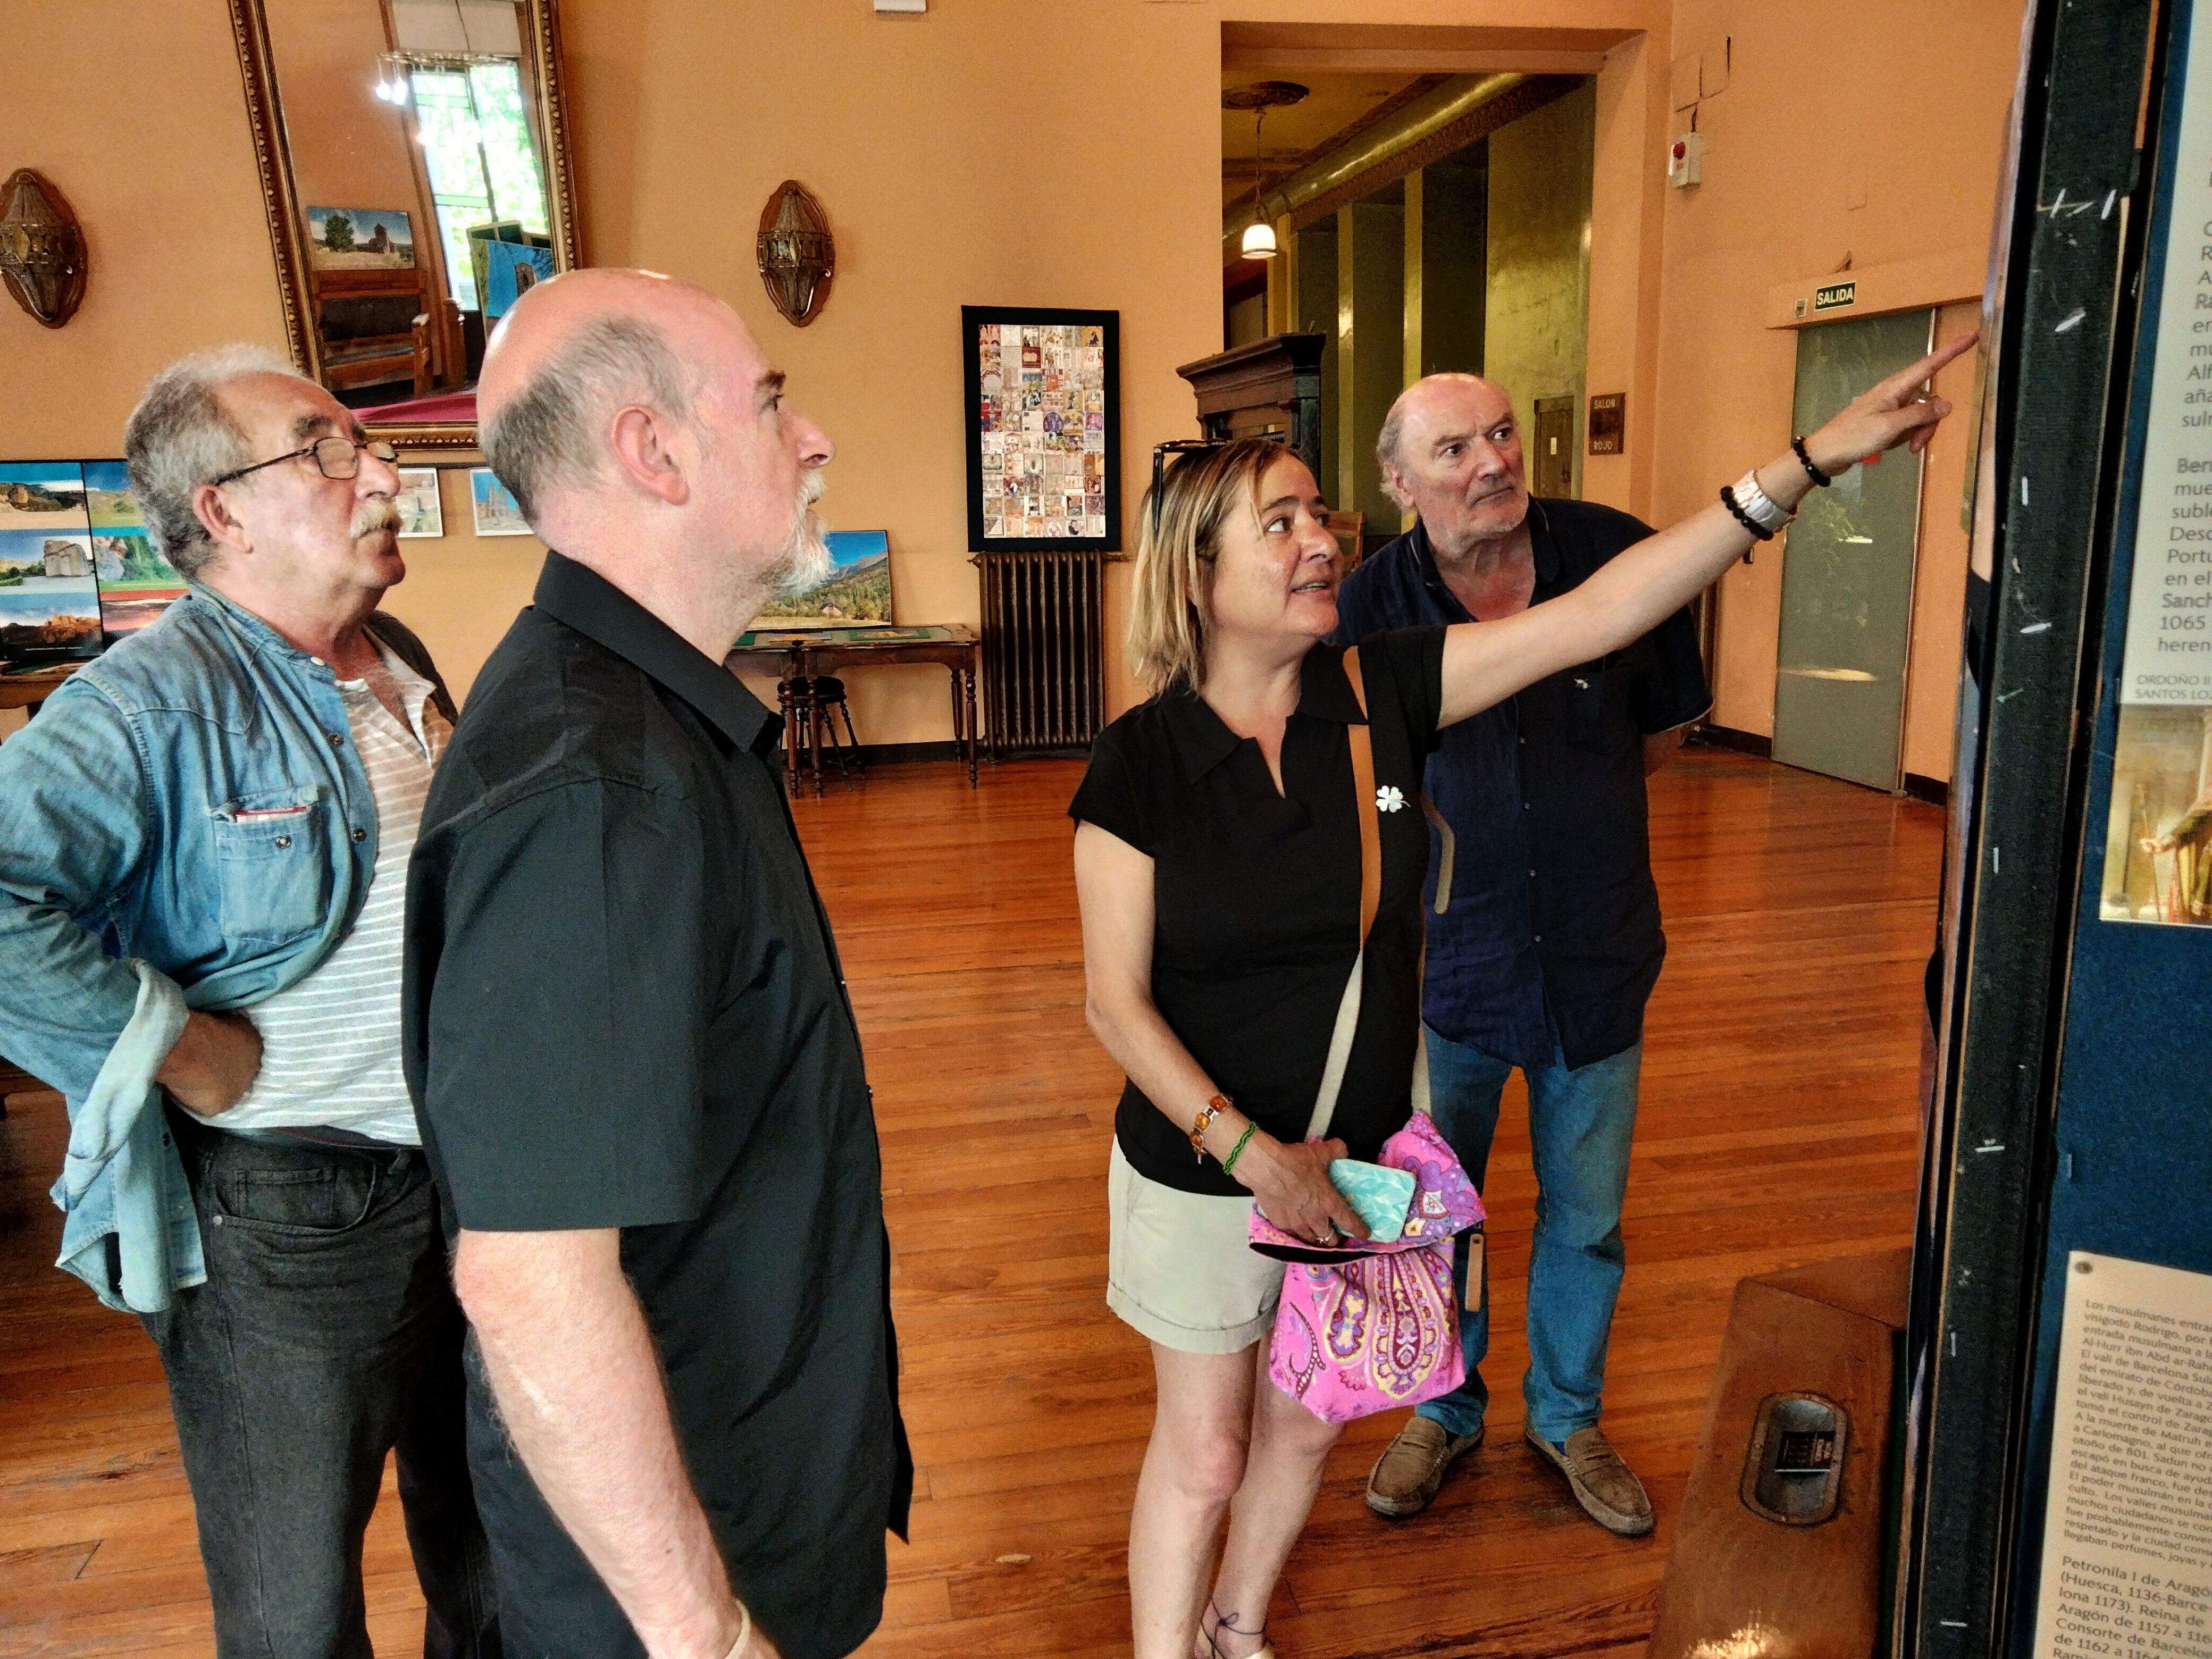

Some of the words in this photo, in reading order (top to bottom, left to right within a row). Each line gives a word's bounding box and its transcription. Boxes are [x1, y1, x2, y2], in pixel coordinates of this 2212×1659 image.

[2197, 270, 2212, 285] A
[1817, 287, 1854, 305] SALIDA
[2165, 573, 2188, 586] en
[2194, 571, 2211, 585] el
[2160, 615, 2206, 631] 1065
[2134, 688, 2186, 699] SANTOS
[2085, 1298, 2104, 1310] Los
[2107, 1305, 2175, 1325] musulmanes
[2083, 1325, 2125, 1340] entrada
[2128, 1335, 2192, 1354] musulmana
[2084, 1312, 2130, 1328] visigodo
[2185, 1335, 2205, 1344] por
[2080, 1348, 2090, 1359] El
[2115, 1356, 2129, 1367] de
[2133, 1360, 2188, 1379] Barcelona
[2125, 1345, 2142, 1356] ibn
[2147, 1350, 2169, 1362] Abd
[2079, 1361, 2097, 1373] del
[2100, 1368, 2143, 1382] emirato
[2146, 1376, 2160, 1386] de
[2077, 1387, 2087, 1396] el
[2113, 1394, 2153, 1412] Husayn
[2156, 1403, 2172, 1414] de
[2139, 1387, 2154, 1398] de
[2157, 1393, 2192, 1406] vuelta
[2075, 1411, 2083, 1420] A
[2087, 1413, 2096, 1423] la
[2099, 1418, 2139, 1432] muerte
[2142, 1425, 2157, 1436] de
[2160, 1429, 2201, 1445] Matruh
[2108, 1406, 2118, 1415] el
[2121, 1410, 2161, 1425] control
[2165, 1418, 2180, 1428] de
[2072, 1436, 2105, 1449] otoño
[2108, 1443, 2122, 1453] de
[2154, 1452, 2188, 1467] Sadun
[2191, 1462, 2206, 1471] no
[2156, 1441, 2166, 1451] al
[2169, 1446, 2191, 1455] que
[2069, 1459, 2087, 1470] del
[2090, 1464, 2128, 1479] ataque
[2172, 1481, 2191, 1493] fue
[2071, 1449, 2109, 1464] escapó
[2113, 1458, 2126, 1467] en
[2130, 1460, 2161, 1474] busca
[2165, 1467, 2180, 1478] de
[2069, 1470, 2079, 1480] El
[2081, 1475, 2115, 1488] poder
[2118, 1483, 2173, 1501] musulmán
[2177, 1496, 2191, 1504] en
[2194, 1497, 2204, 1507] la
[2105, 1490, 2122, 1502] Los
[2065, 1505, 2083, 1517] fue
[2086, 1512, 2170, 1536] probablemente
[2067, 1496, 2108, 1511] muchos
[2112, 1505, 2173, 1524] ciudadanos
[2177, 1520, 2189, 1528] se
[2064, 1519, 2118, 1537] respetado
[2121, 1532, 2129, 1541] y
[2131, 1531, 2141, 1541] la
[2144, 1536, 2181, 1550] ciudad
[2063, 1529, 2108, 1546] llegaban
[2111, 1541, 2165, 1561] perfumes,
[2167, 1553, 2196, 1565] joyas
[2199, 1560, 2206, 1570] y
[2060, 1571, 2123, 1597] (Huesca,
[2062, 1555, 2127, 1579] Petronila
[2141, 1573, 2160, 1586] de
[2057, 1602, 2109, 1623] Aragón
[2114, 1614, 2133, 1628] de
[2138, 1619, 2170, 1636] 1157
[2173, 1629, 2182, 1638] a
[2058, 1587, 2089, 1603] lona
[2094, 1594, 2134, 1614] 1173).
[2139, 1604, 2181, 1622] Reina
[2184, 1614, 2204, 1627] de
[2054, 1632, 2073, 1646] de
[2076, 1637, 2110, 1654] 1162
[2113, 1647, 2123, 1656] a
[2055, 1617, 2123, 1641] Consorte
[2126, 1632, 2146, 1646] de
